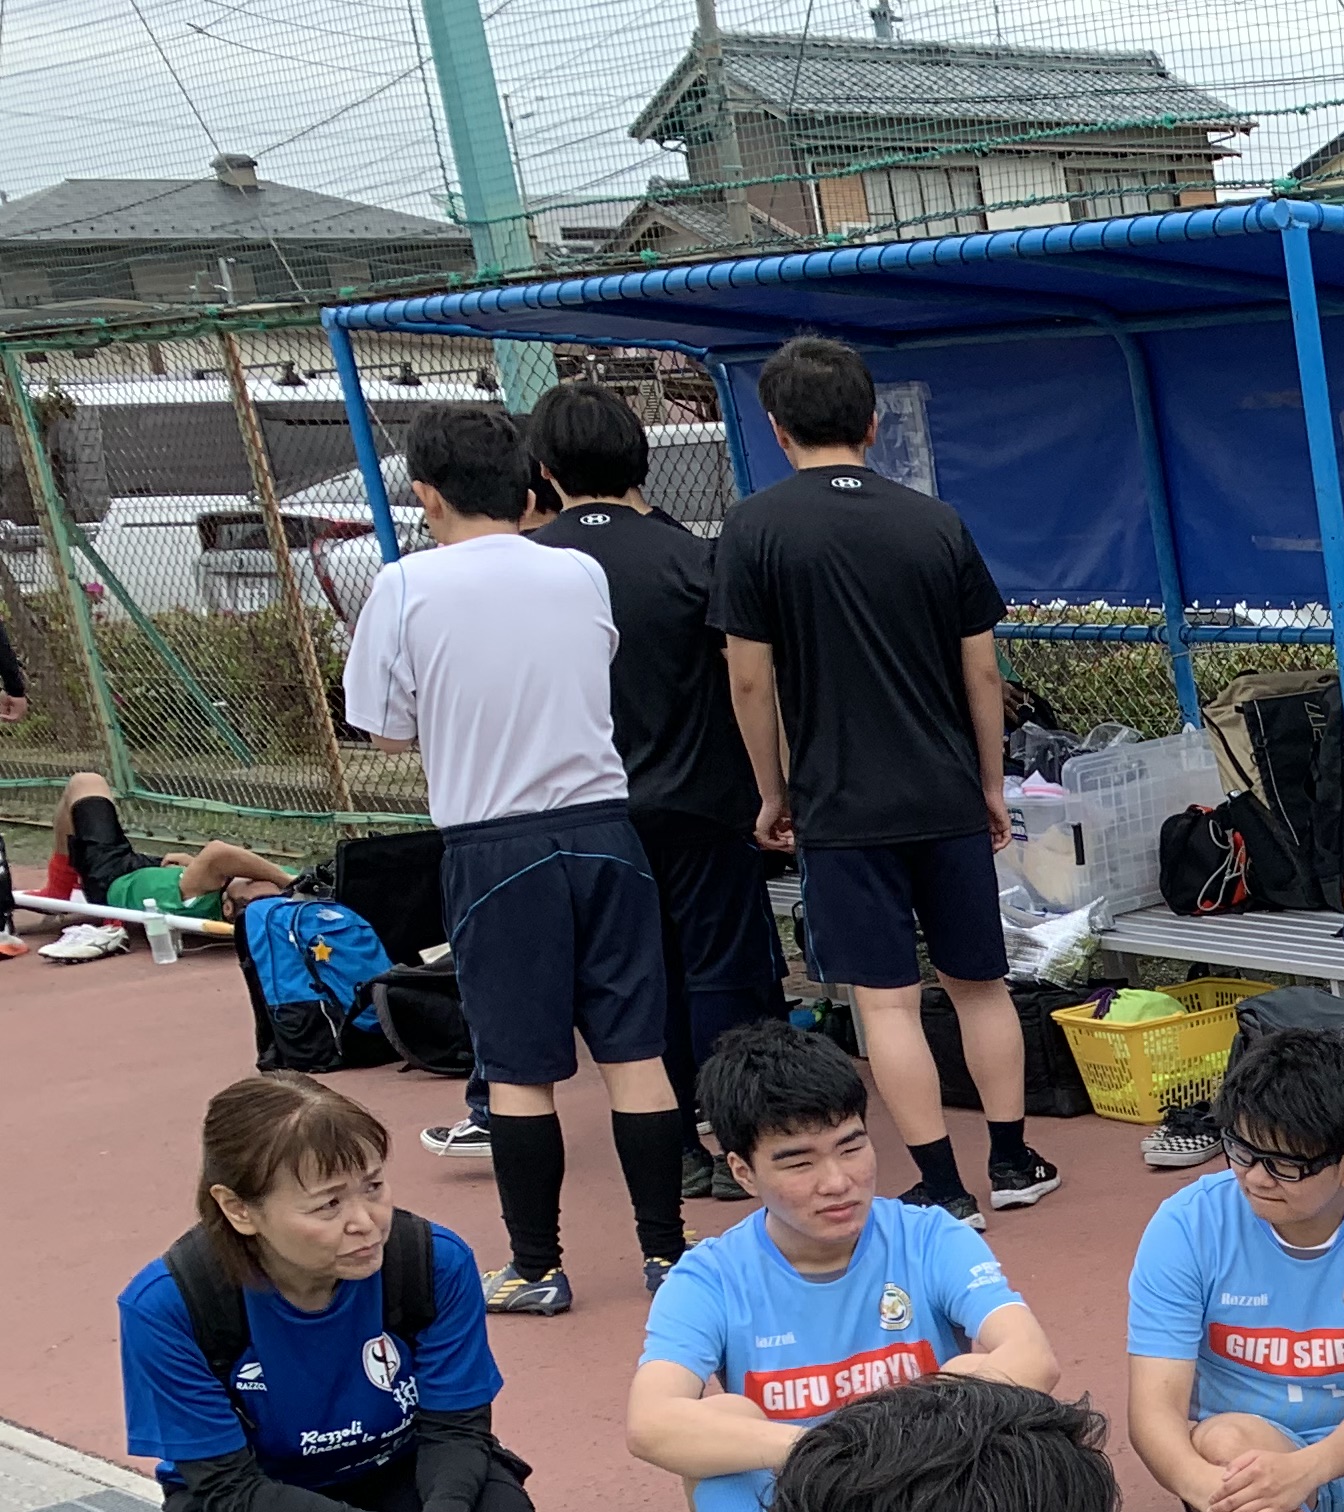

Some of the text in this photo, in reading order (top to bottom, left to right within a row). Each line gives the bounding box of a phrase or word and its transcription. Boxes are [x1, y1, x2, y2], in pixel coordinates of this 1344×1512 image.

[1225, 1333, 1289, 1366] GIFU
[762, 1374, 831, 1412] GIFU
[299, 1420, 363, 1447] Razzoli
